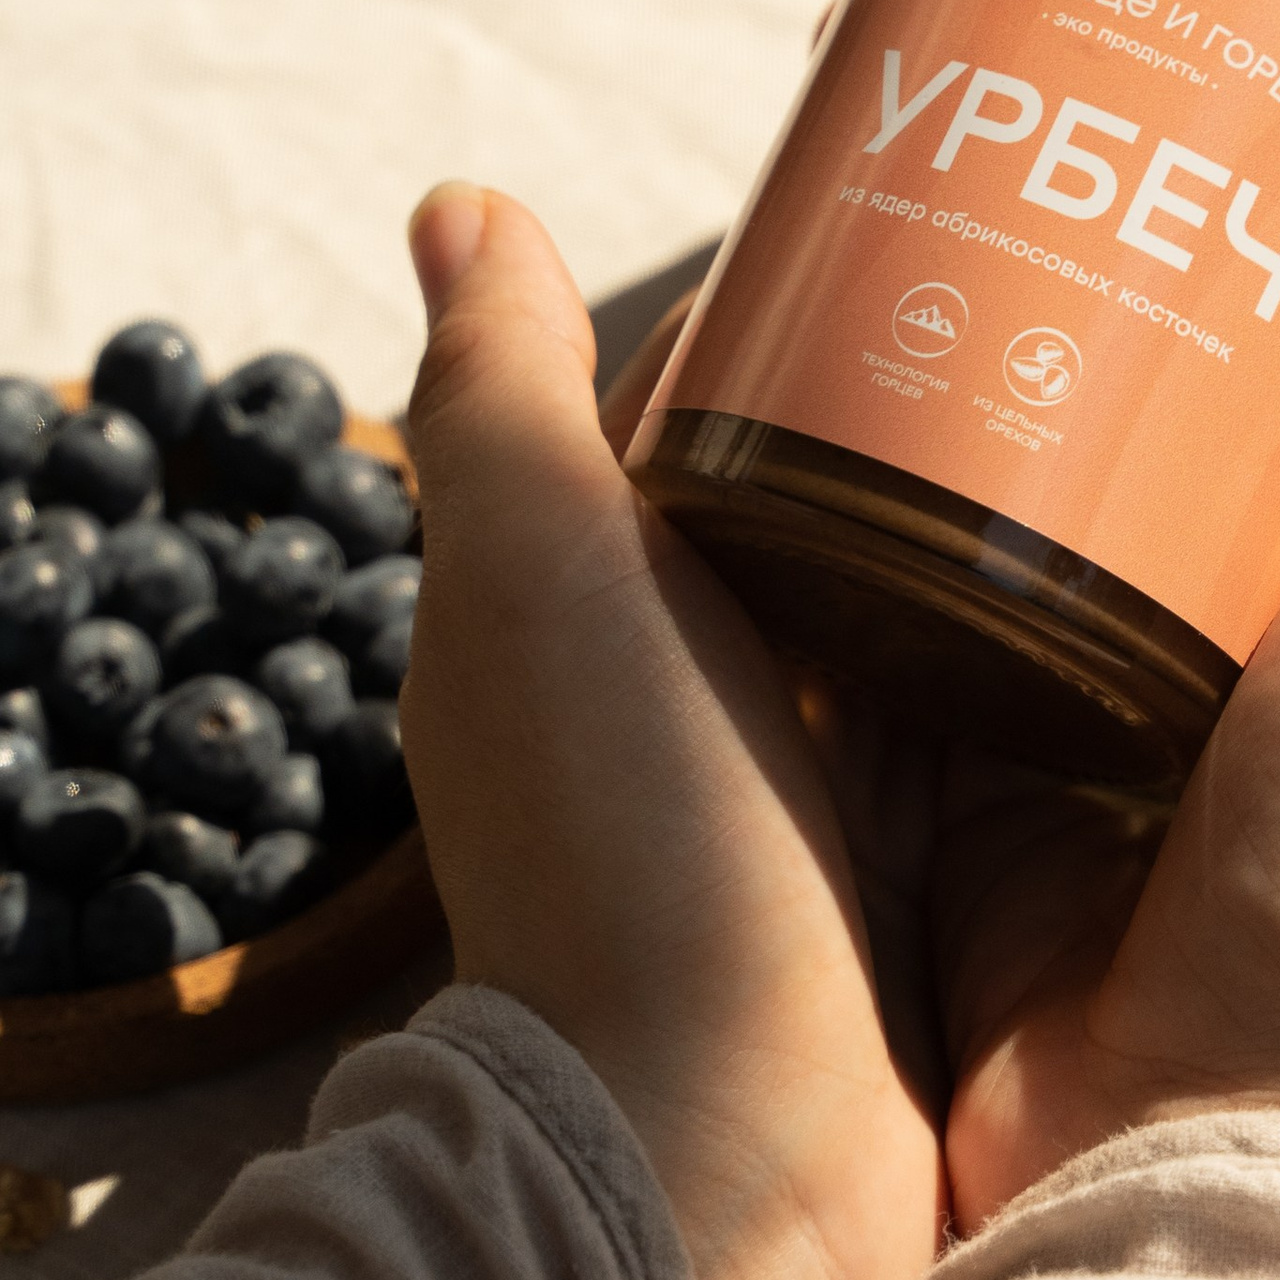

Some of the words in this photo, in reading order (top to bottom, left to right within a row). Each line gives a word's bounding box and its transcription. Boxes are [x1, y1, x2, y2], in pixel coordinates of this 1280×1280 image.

[1163, 3, 1199, 39] И
[1053, 12, 1092, 36] эко
[1096, 26, 1208, 86] продукты
[839, 185, 864, 205] из
[868, 193, 926, 223] ядер
[932, 209, 1114, 296] абрикосовых
[1118, 286, 1236, 364] косточек
[861, 351, 950, 394] ТЕХНОЛОГИЯ
[871, 372, 925, 400] ГОРЦЕВ
[973, 395, 993, 412] ИЗ
[995, 404, 1065, 445] ЦЕЛЬНЫХ
[985, 418, 1042, 452] ОРЕХОВ
